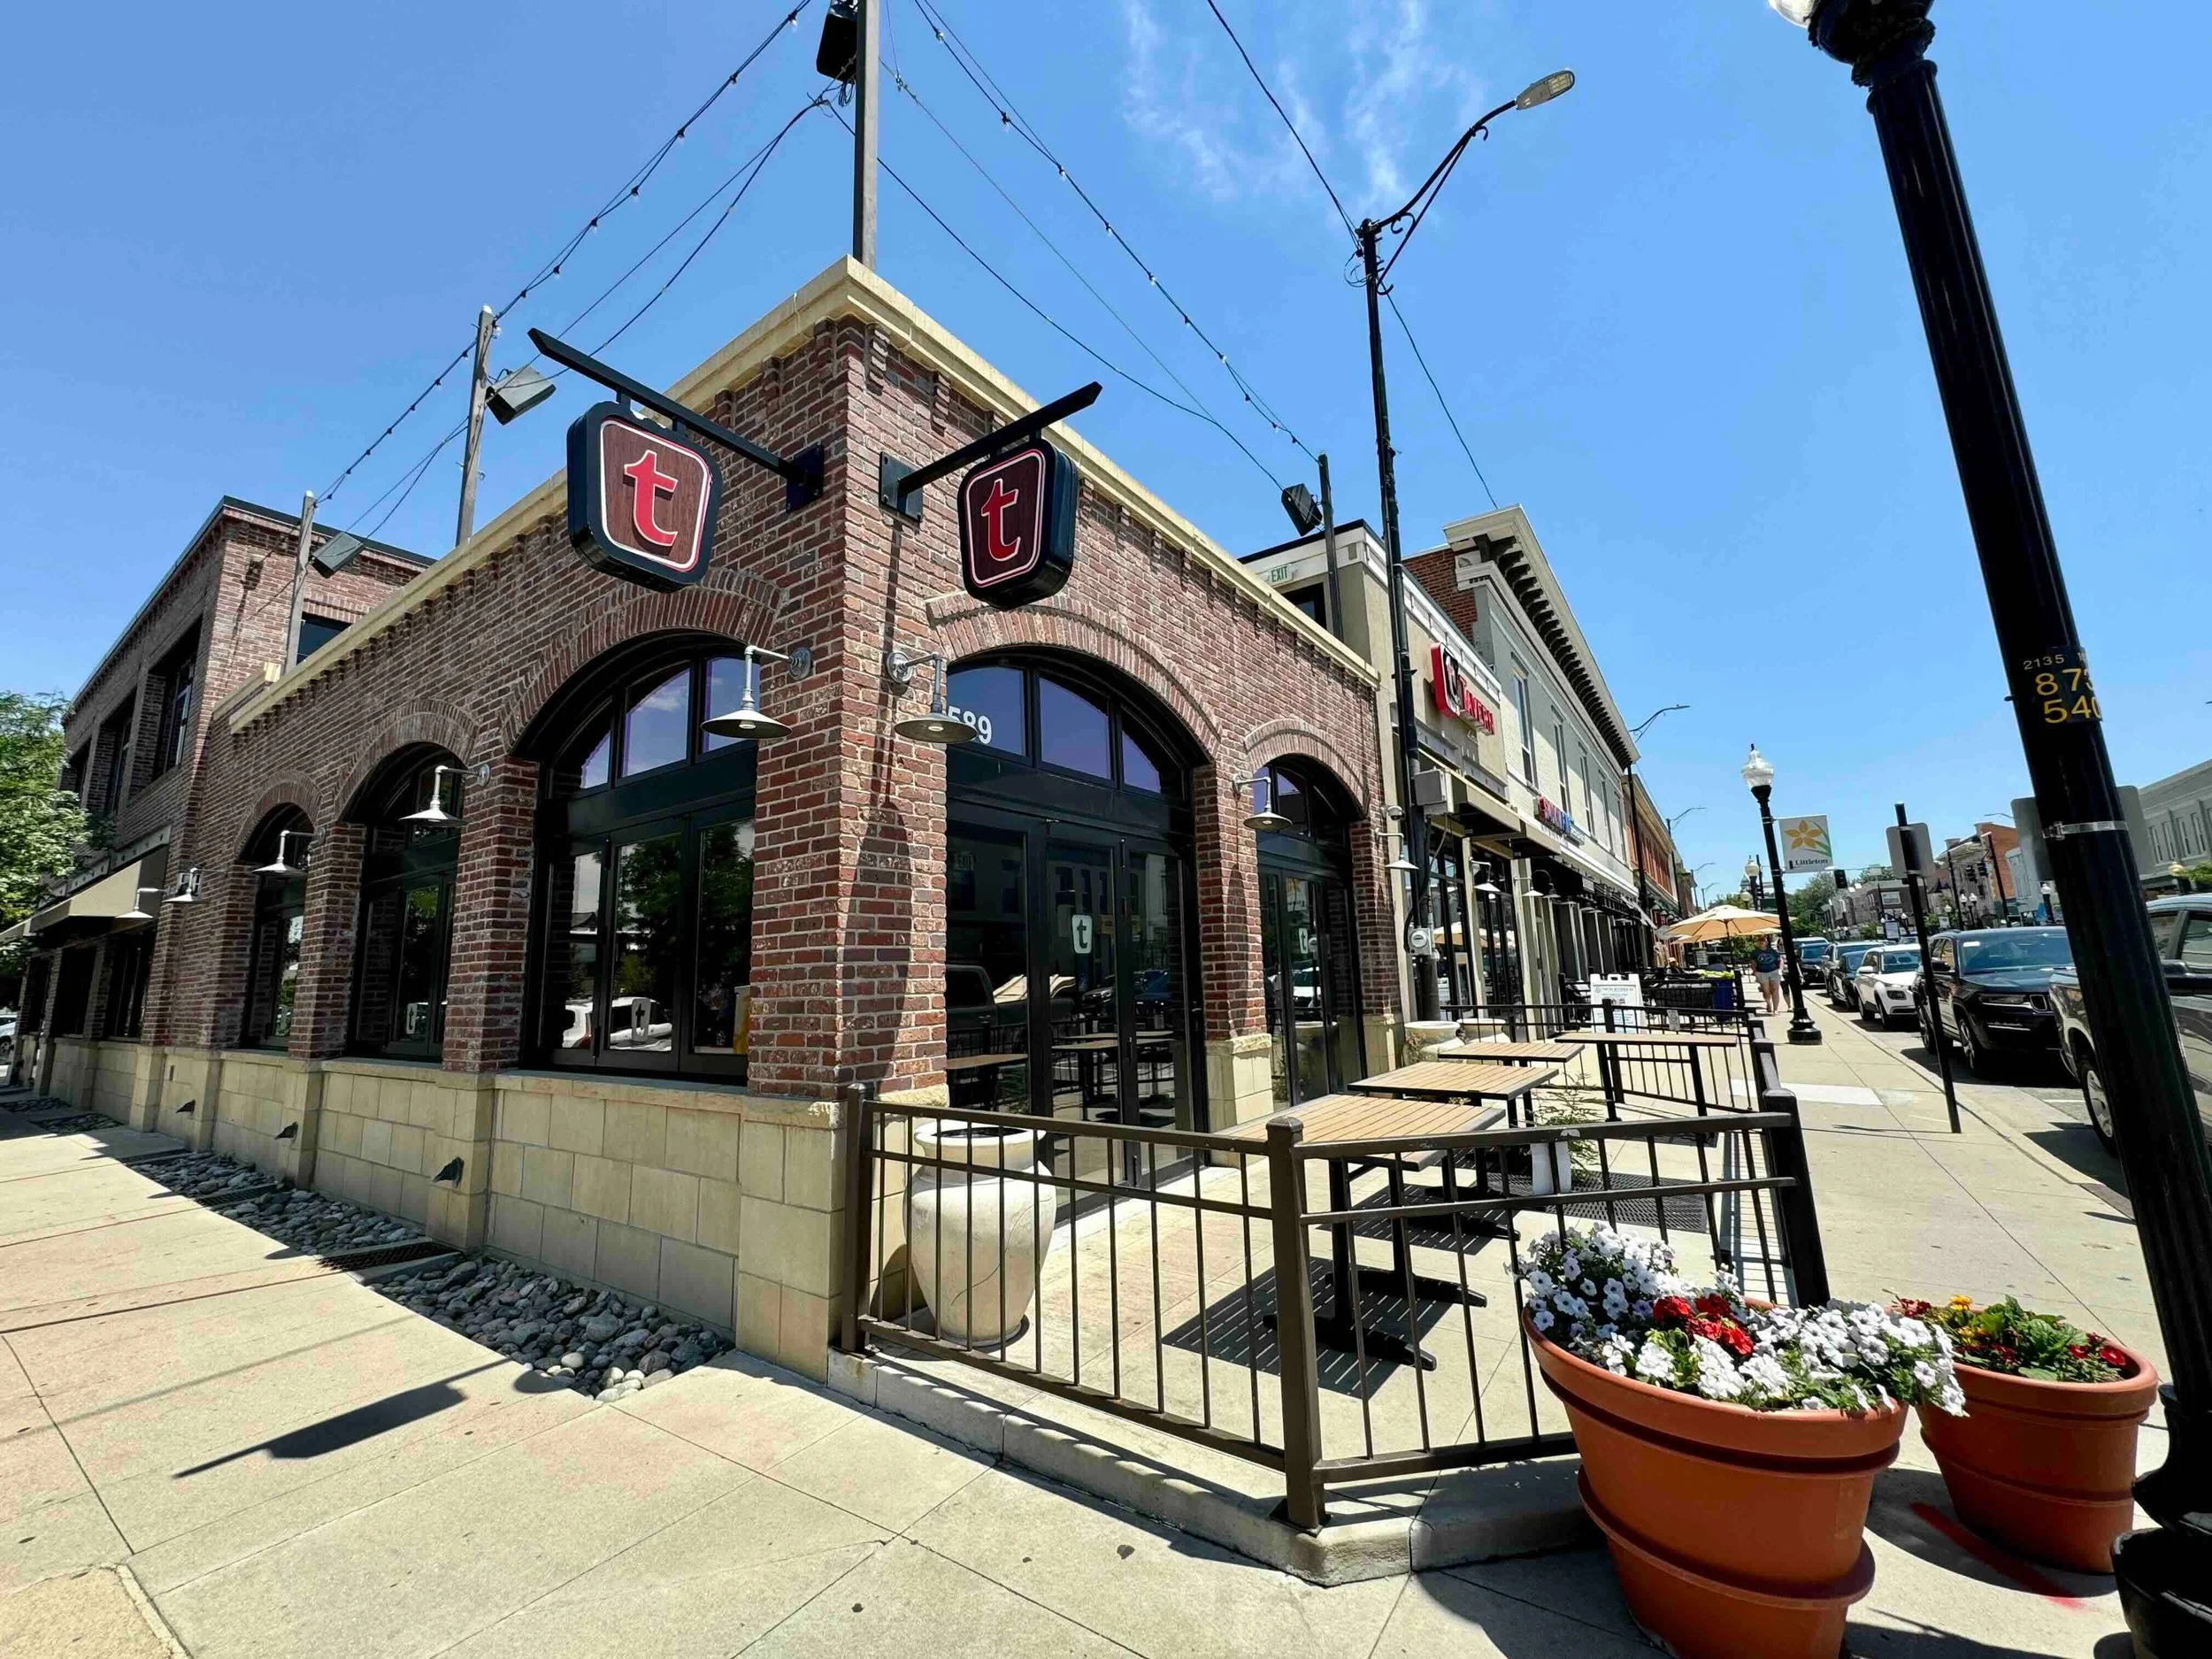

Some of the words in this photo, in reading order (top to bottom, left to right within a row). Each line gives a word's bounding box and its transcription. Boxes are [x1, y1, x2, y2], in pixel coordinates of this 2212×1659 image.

[624, 449, 679, 546] t
[980, 478, 1021, 562] t
[1271, 565, 1288, 583] EXIT
[2023, 654, 2065, 671] 2135
[1795, 857, 1828, 866] Littleton
[1077, 918, 1088, 949] t
[635, 1003, 646, 1036] t
